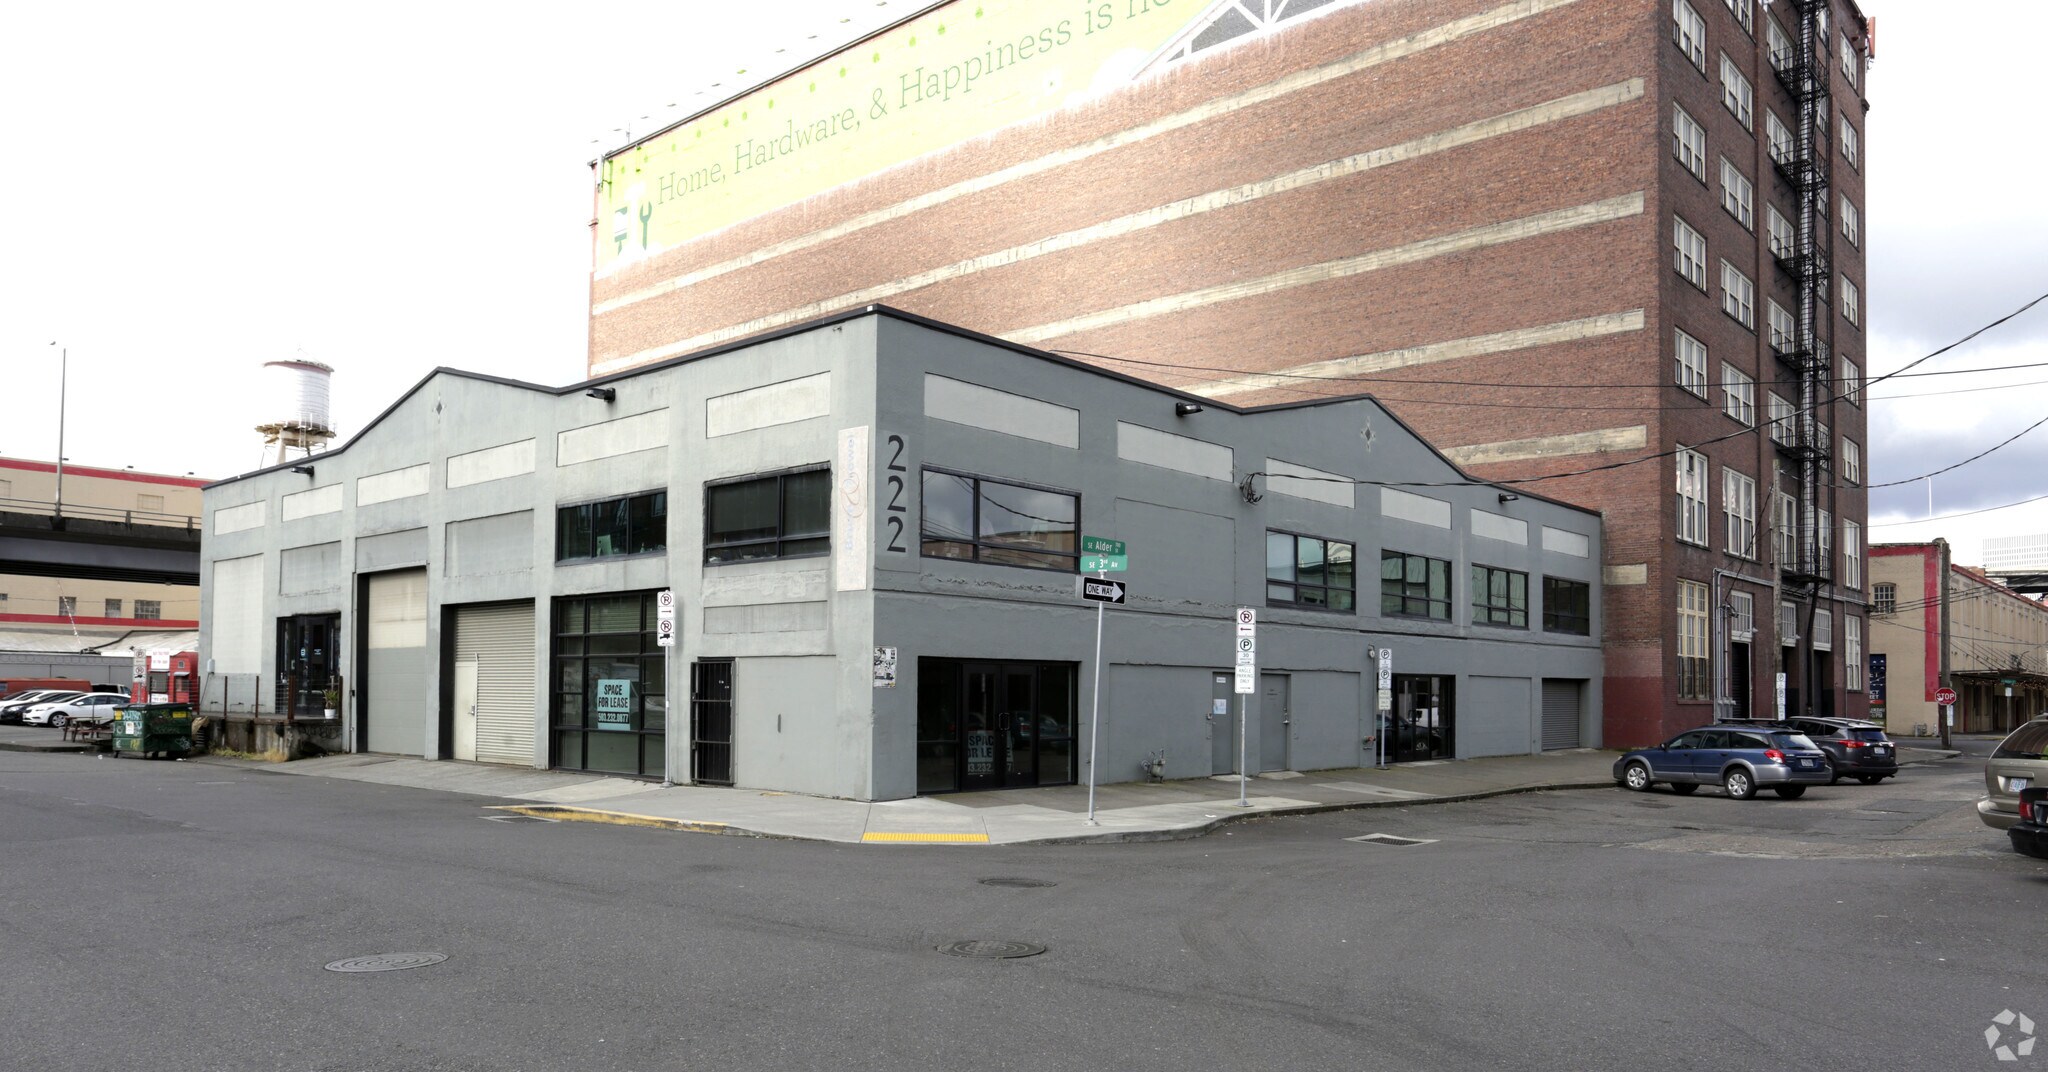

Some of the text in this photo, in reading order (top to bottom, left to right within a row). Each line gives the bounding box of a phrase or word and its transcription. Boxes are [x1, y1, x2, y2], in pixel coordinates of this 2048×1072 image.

[658, 163, 726, 205] Home,
[734, 108, 860, 174] Hardware,
[869, 88, 888, 120] &
[899, 20, 1071, 109] Happiness
[1084, 0, 1113, 36] is
[1095, 541, 1113, 551] Alder
[1088, 584, 1113, 596] ONE WAY
[604, 684, 622, 696] SPACE
[598, 697, 628, 708] FOR LEASE
[1936, 693, 1955, 701] STOP
[969, 735, 994, 746] SPAC
